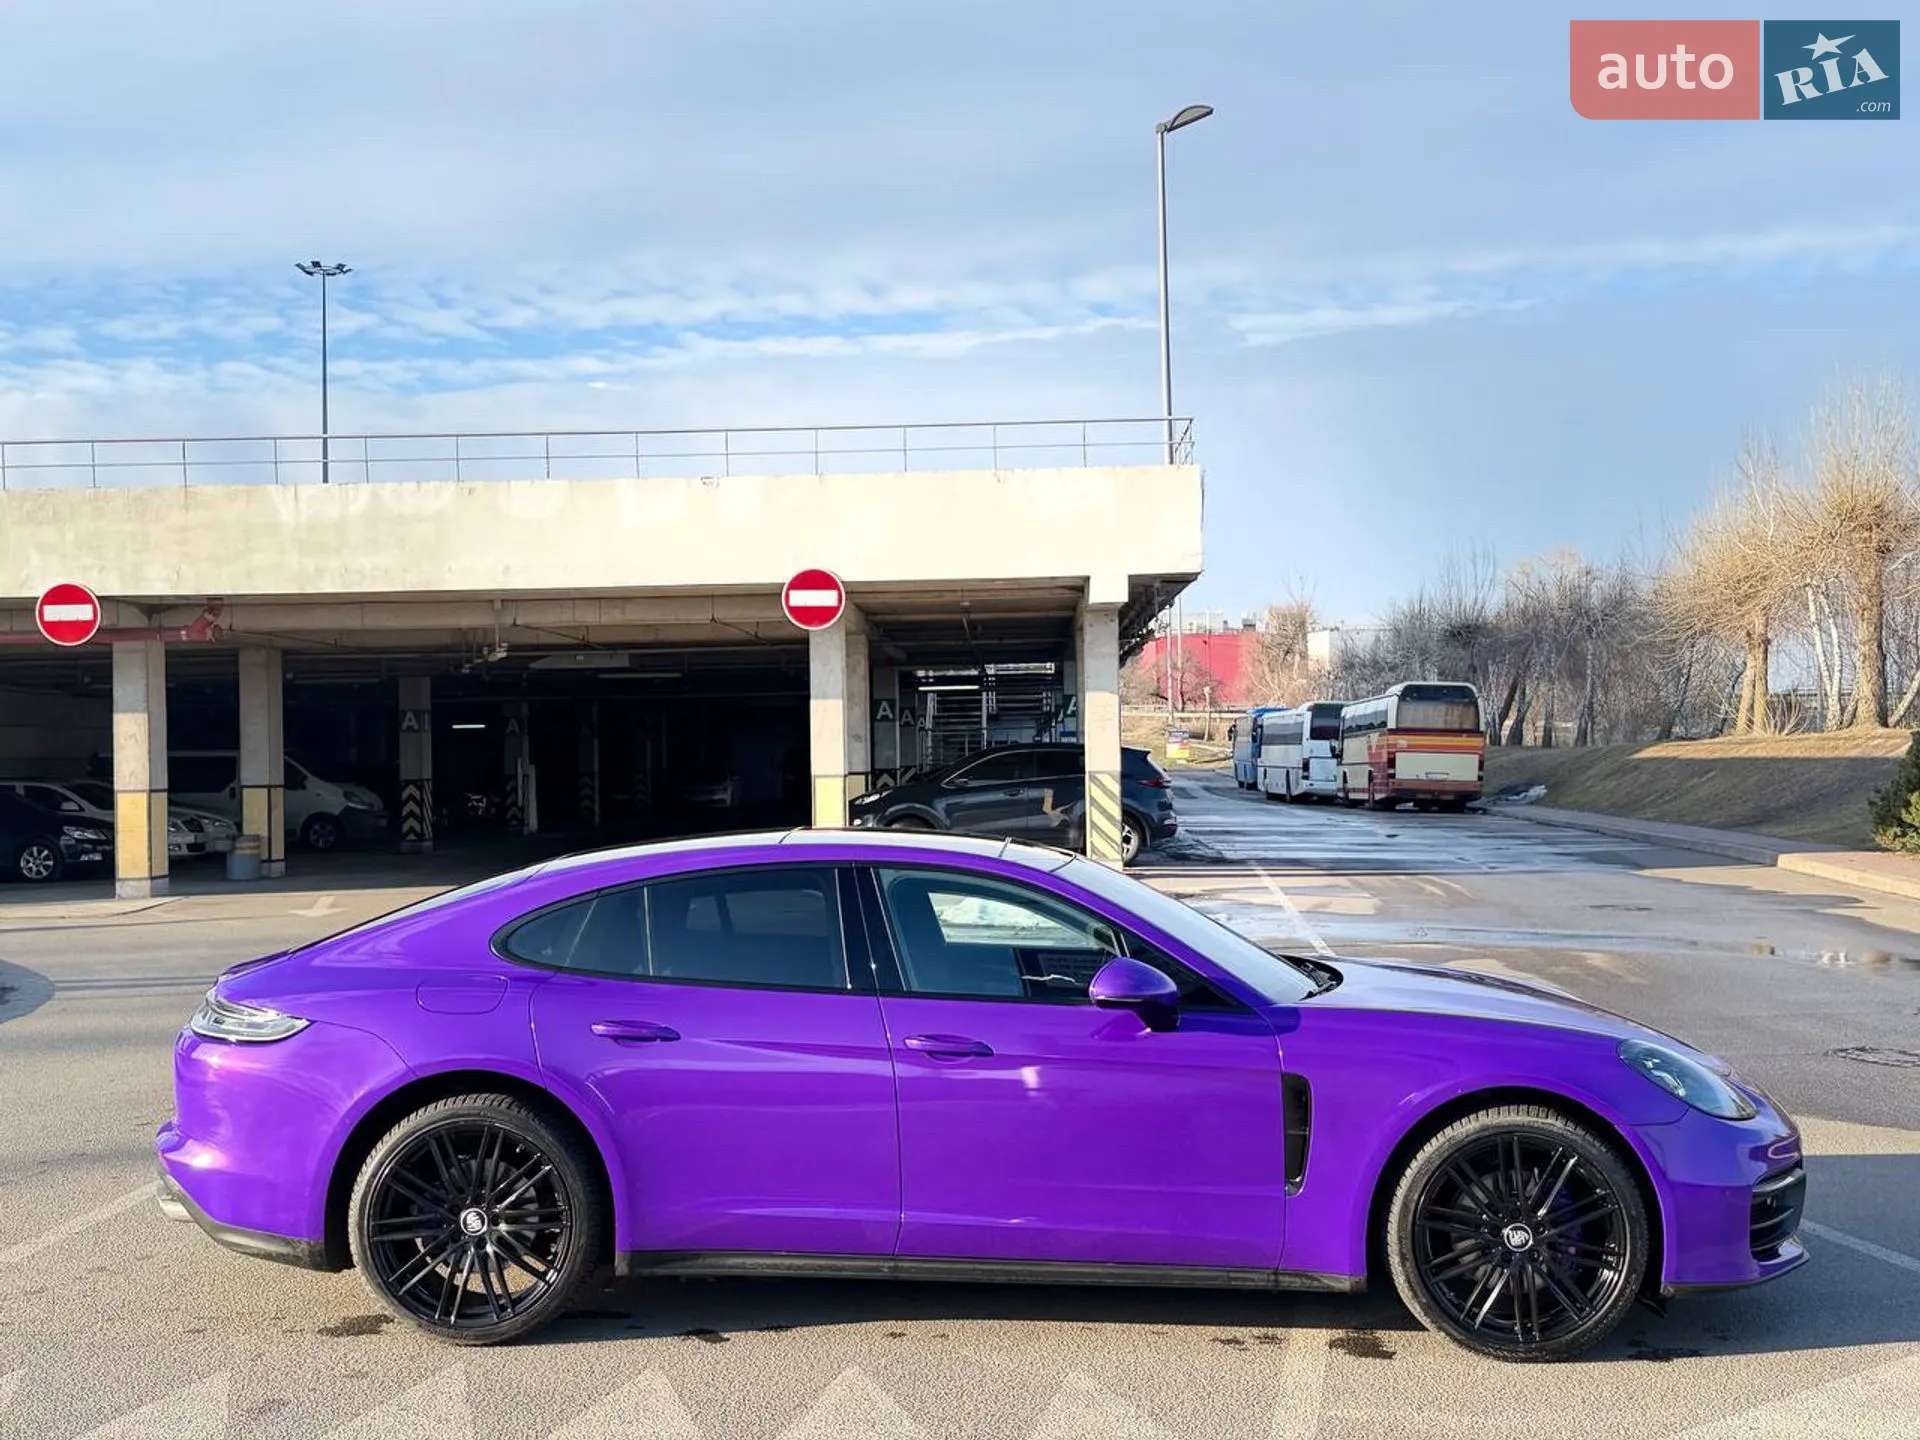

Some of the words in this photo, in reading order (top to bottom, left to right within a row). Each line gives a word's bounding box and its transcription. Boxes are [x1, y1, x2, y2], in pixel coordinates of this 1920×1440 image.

[876, 700, 893, 720] A
[900, 709, 915, 725] A
[402, 711, 419, 730] A
[506, 718, 520, 734] A
